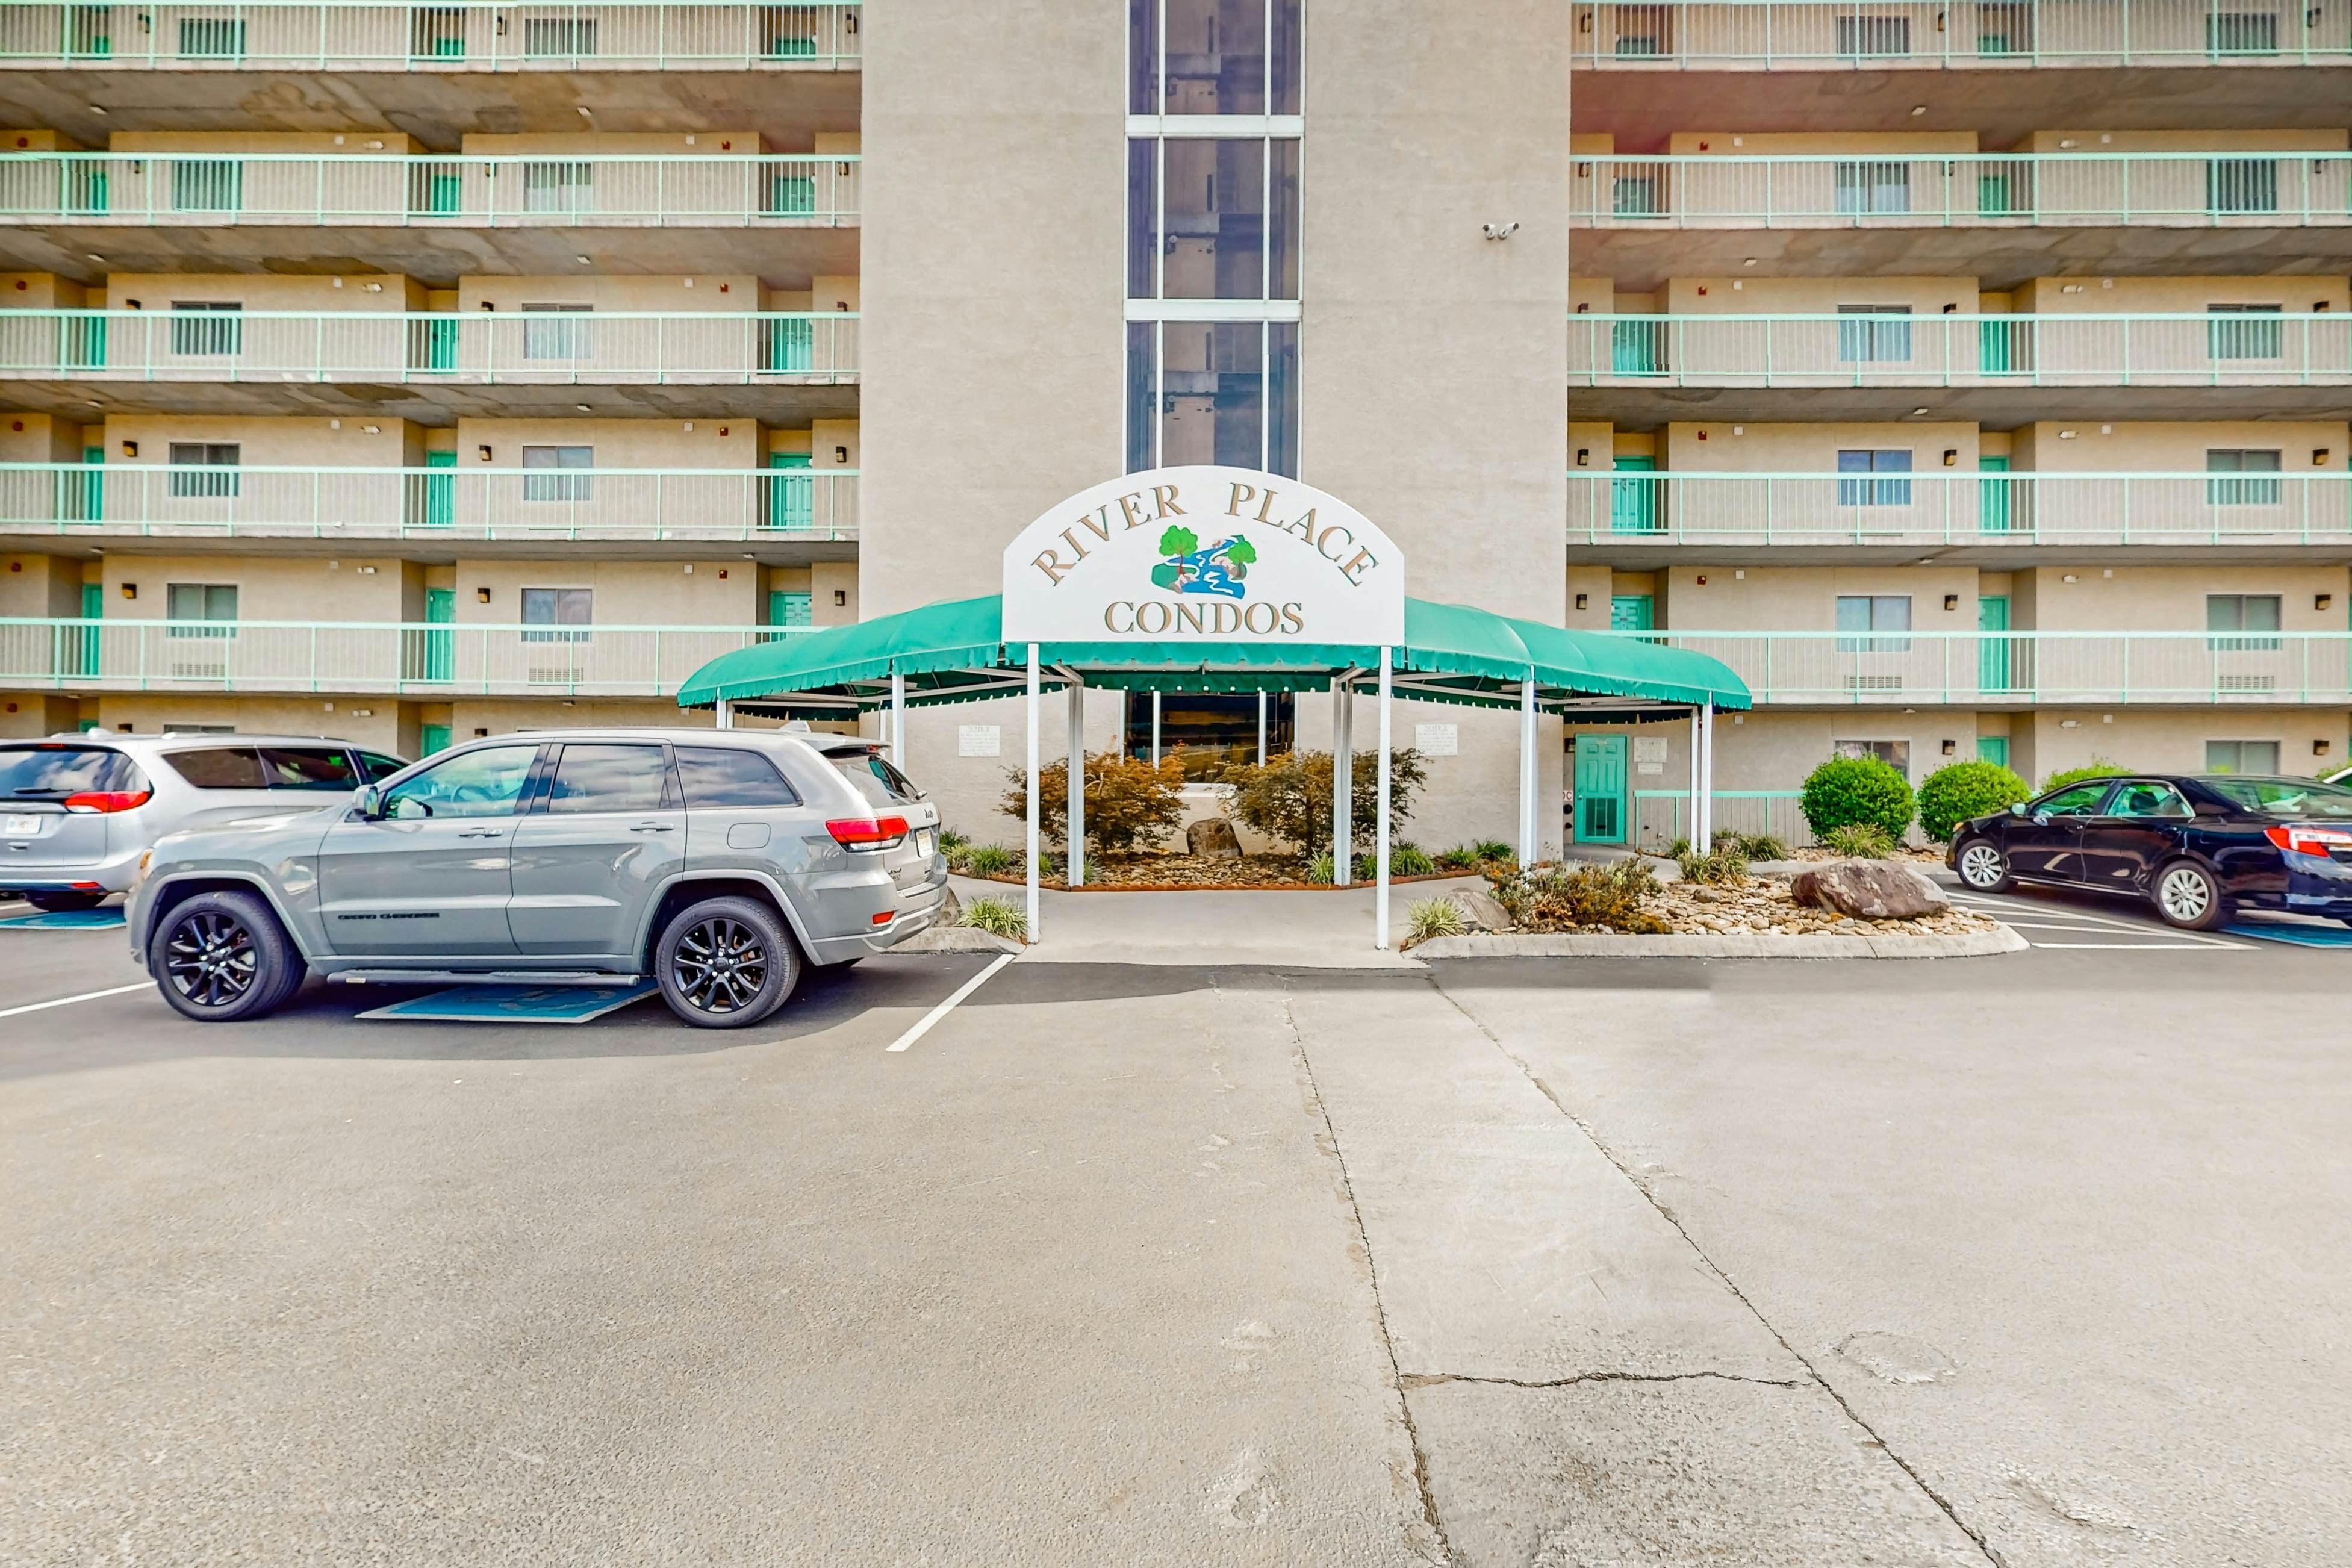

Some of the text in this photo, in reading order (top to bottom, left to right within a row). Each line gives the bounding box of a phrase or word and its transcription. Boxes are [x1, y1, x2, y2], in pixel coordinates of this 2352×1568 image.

[1030, 482, 1380, 587] RIVER PLACE
[1104, 601, 1304, 635] CONDOS
